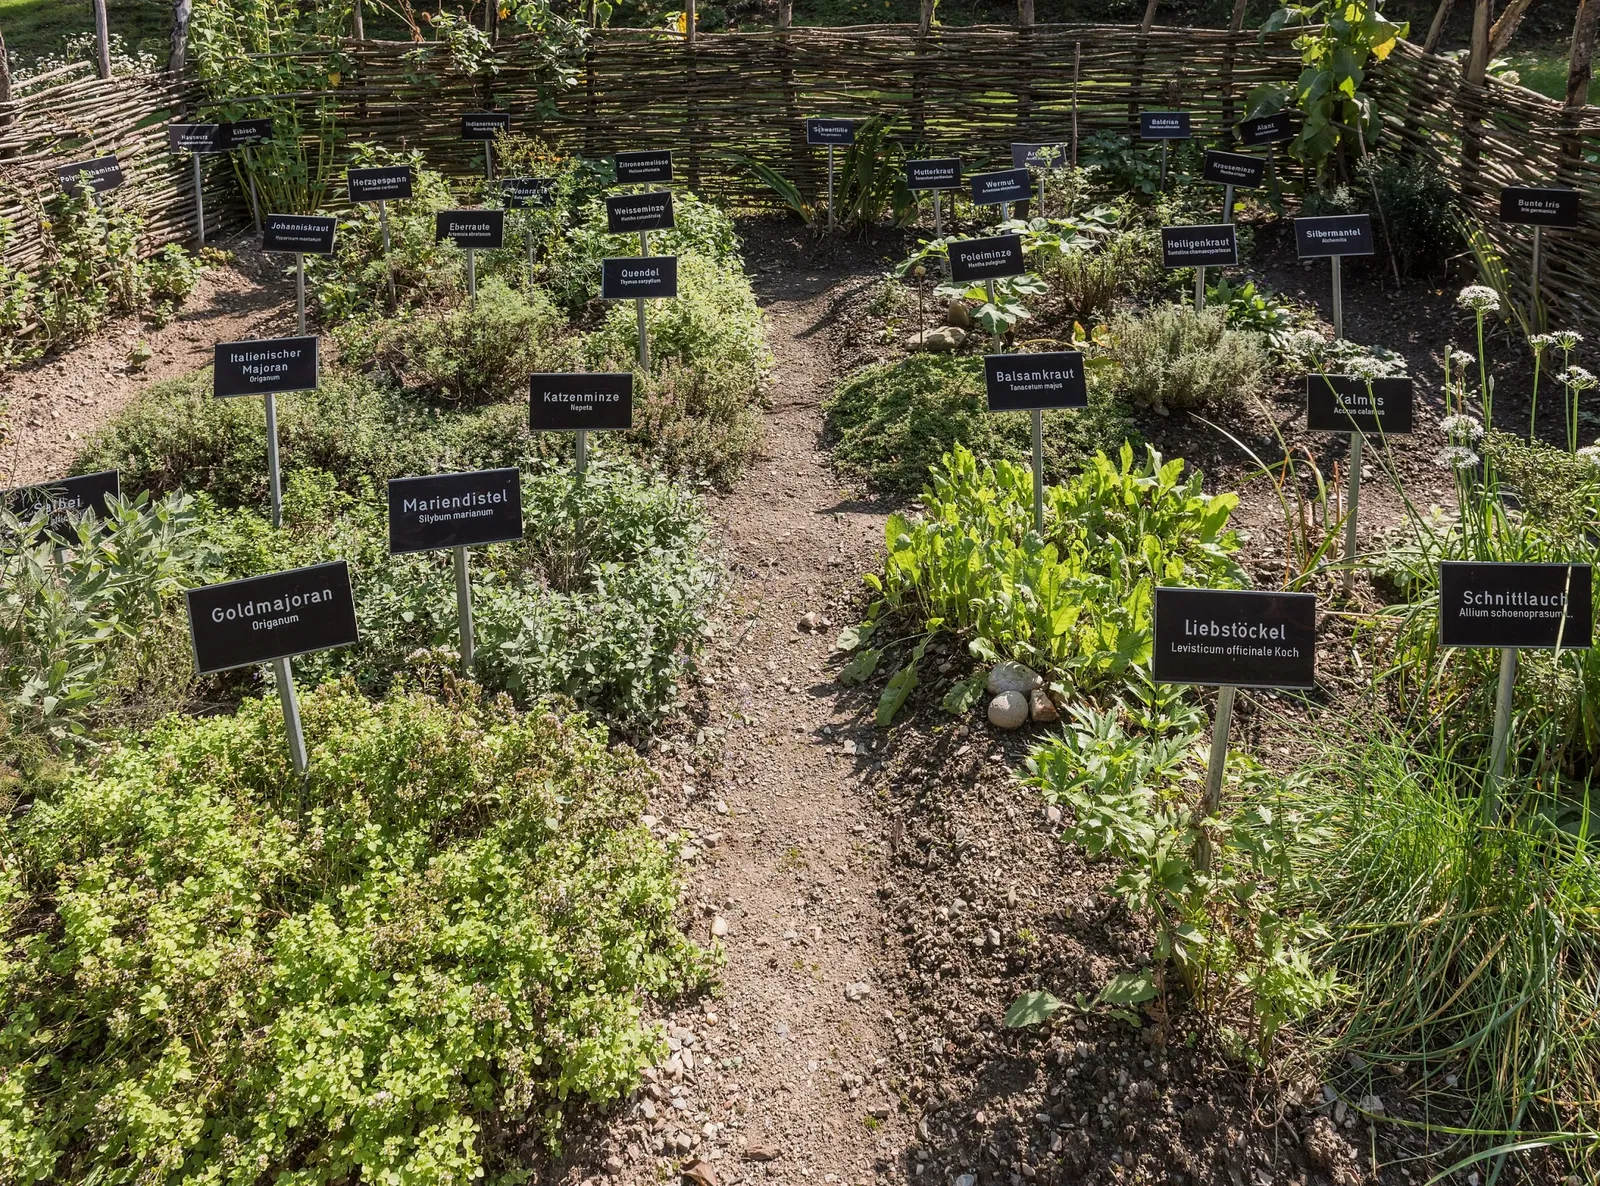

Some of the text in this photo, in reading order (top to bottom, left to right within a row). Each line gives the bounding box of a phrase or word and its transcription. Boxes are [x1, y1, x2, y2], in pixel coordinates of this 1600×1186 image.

[232, 127, 257, 135] Eibisch
[1257, 122, 1275, 131] Alant
[618, 159, 669, 168] Zitronenmelisse
[1213, 161, 1255, 174] Krauseminze
[353, 176, 407, 186] Herzgespann
[985, 179, 1015, 188] Wermut
[1518, 199, 1560, 209] Bunte Iris
[614, 205, 665, 215] Weisseminze
[271, 222, 329, 232] Johanniskraut
[449, 222, 490, 231] Eberraute
[1306, 228, 1361, 238] Silbermantel
[1167, 238, 1230, 249] Heiligenkraut
[960, 250, 1012, 262] Poleiminze
[985, 259, 1006, 267] pulegium
[621, 268, 660, 278] Quendel
[230, 349, 302, 363] Italienischer
[242, 363, 288, 375] Majoran
[249, 375, 280, 383] Origanum
[996, 368, 1074, 382] Balsamkraut
[1044, 382, 1063, 390] majus
[543, 392, 620, 402] Katzenminze
[570, 404, 593, 412] Nepeta
[403, 488, 508, 513] Mariendistel
[418, 508, 494, 524] Silybum marianum
[1463, 590, 1568, 606] Schnittlauch
[211, 588, 333, 623] Goldmajoran
[1459, 607, 1489, 617] Allium
[1490, 608, 1563, 620] schoenoprasum
[252, 613, 299, 631] Origanum
[1185, 619, 1286, 640] Liebstöckel
[1171, 642, 1299, 658] Levisticum officinale Koch
